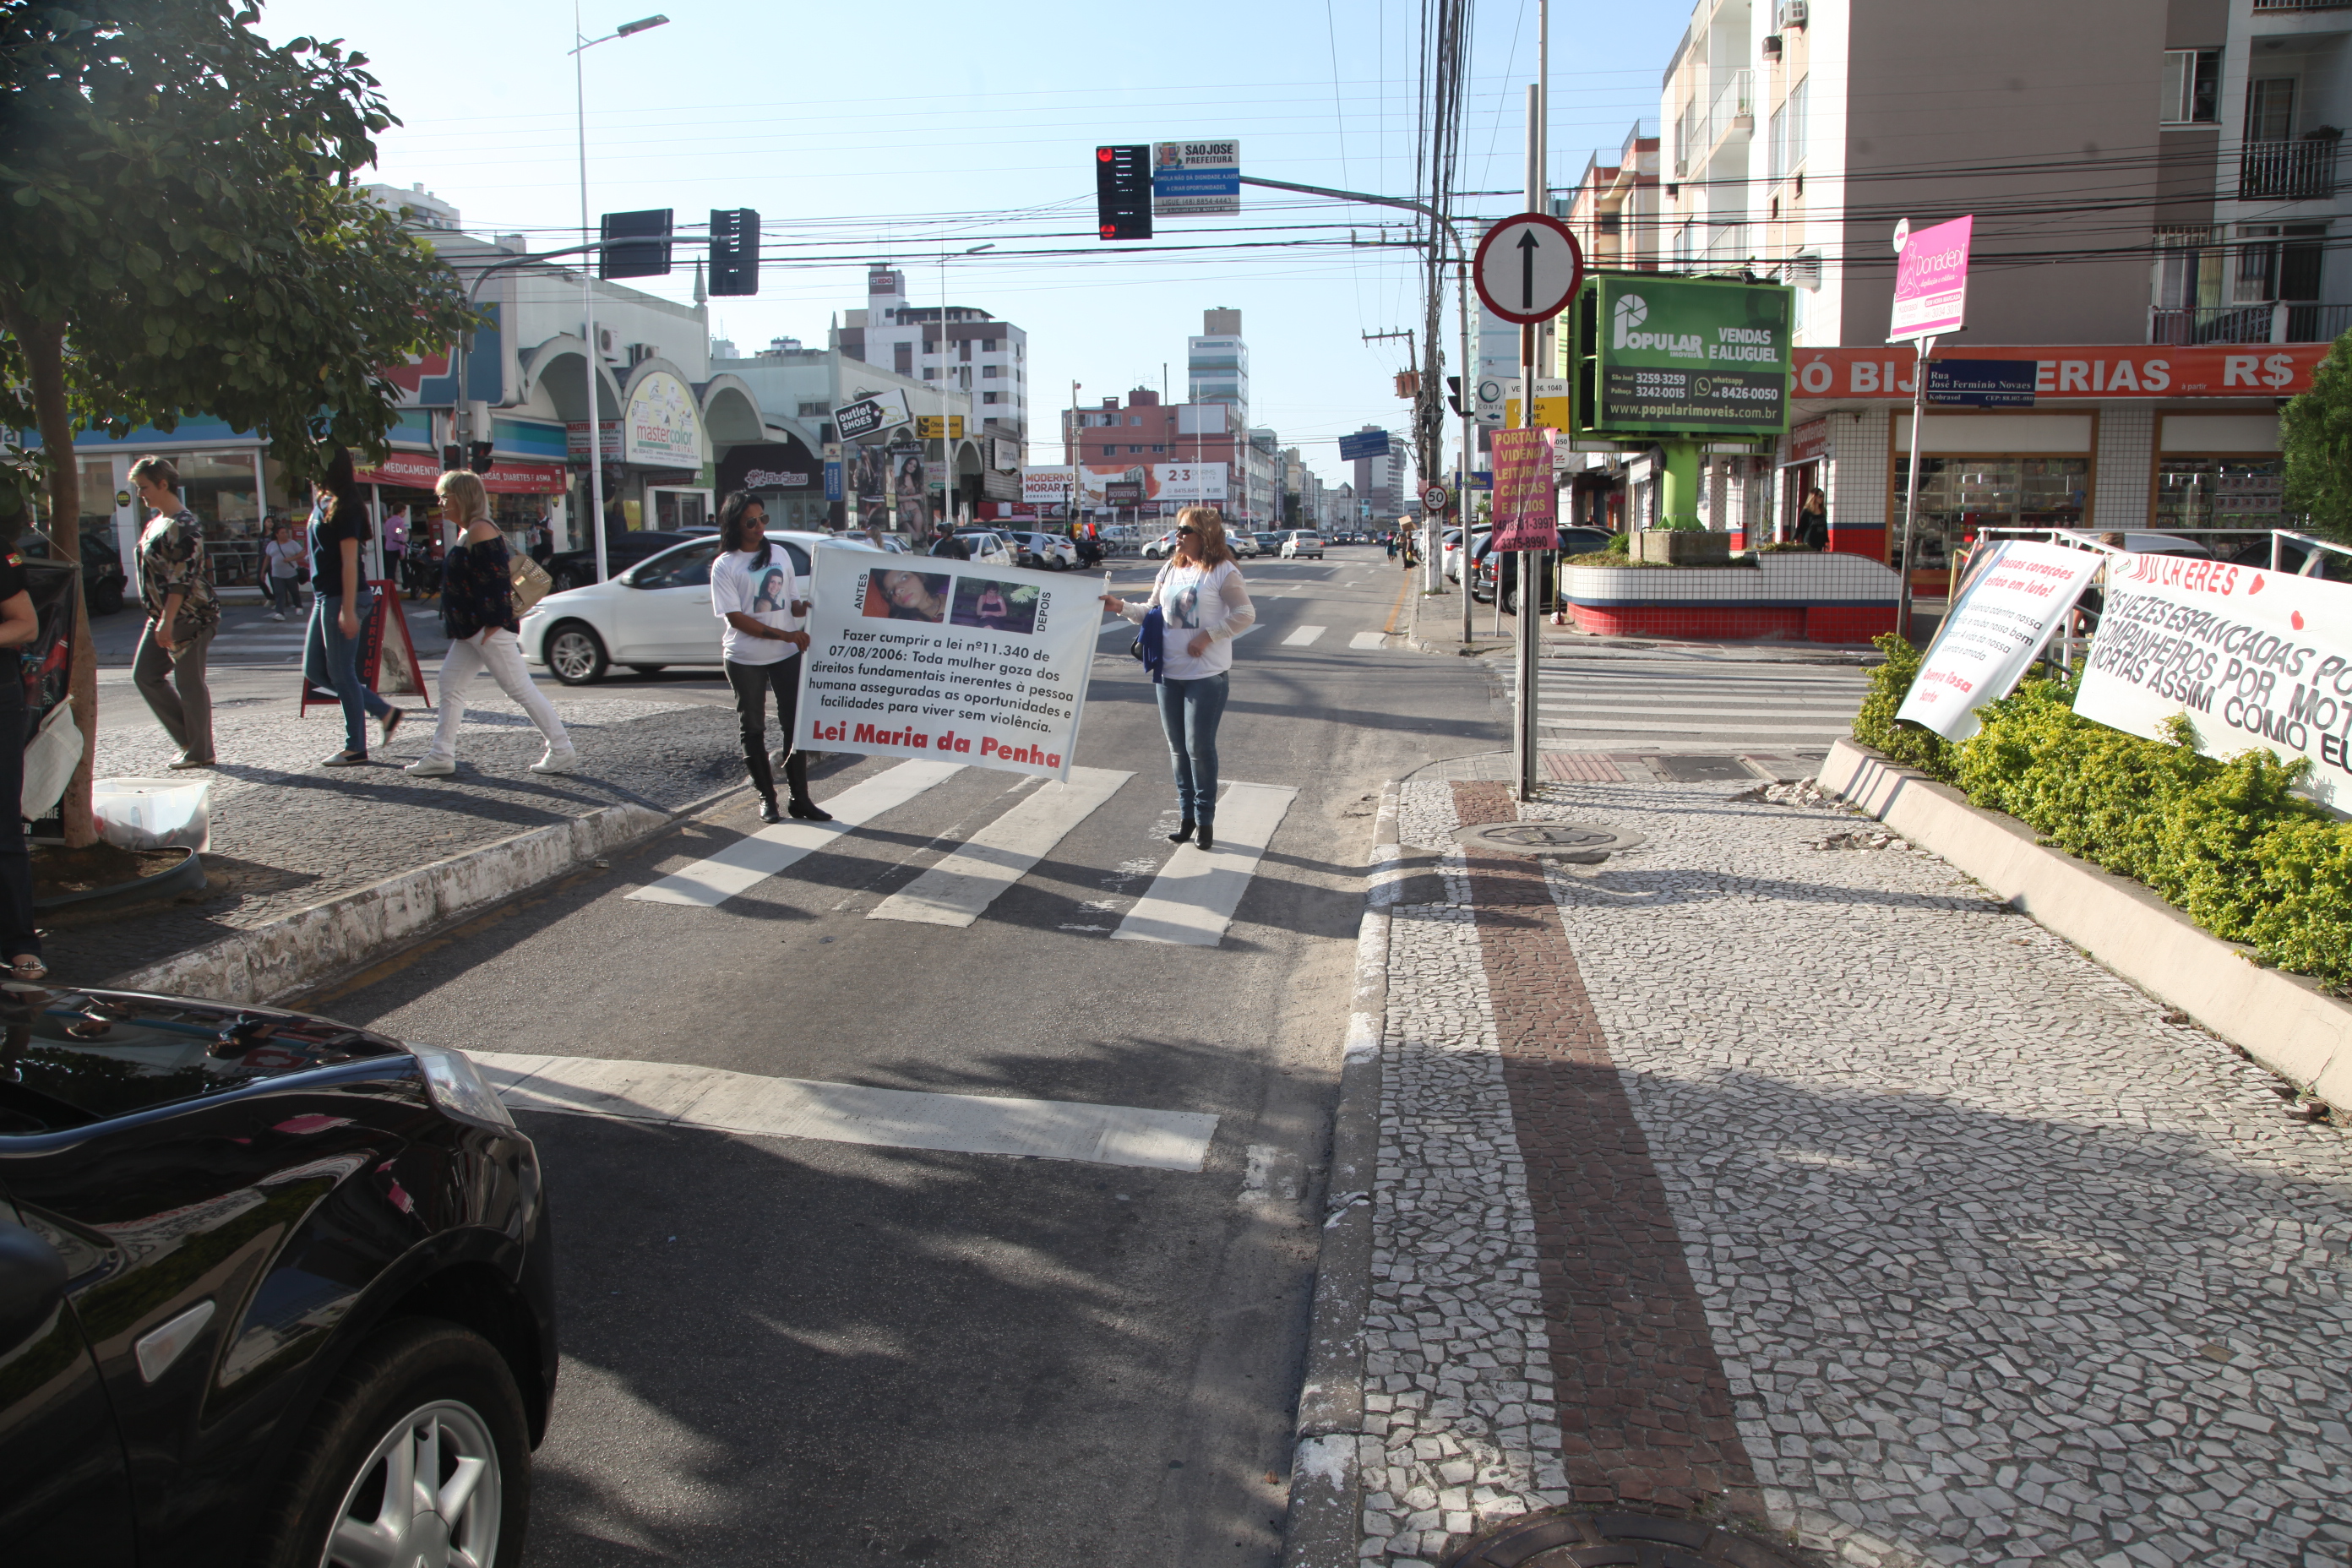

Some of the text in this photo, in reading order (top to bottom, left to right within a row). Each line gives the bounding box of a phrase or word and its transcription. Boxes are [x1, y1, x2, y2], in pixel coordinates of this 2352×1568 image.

[1185, 143, 1233, 155] SÃO JOSÉ
[1186, 155, 1233, 164] PREFEITURA
[1916, 243, 1965, 275] Donadepil
[1898, 301, 1918, 313] Kobrasol
[1932, 308, 1945, 318] 3034
[1946, 303, 1960, 315] 3010
[1614, 294, 1704, 358] POPULAR
[1718, 328, 1771, 345] VENDAS
[1709, 345, 1778, 362] E ALUGUEL
[1636, 373, 1685, 384] 3259-3259
[2224, 353, 2294, 389] R$
[1712, 377, 1743, 385] whatsapp
[1636, 387, 1685, 398] 3242-0015
[1722, 387, 1778, 400] 8426-0050
[839, 404, 871, 422] outlet
[1610, 404, 1777, 419] www.popularimoveis.com.br
[842, 415, 872, 431] SHOES
[637, 424, 693, 446] mastercolor
[1495, 431, 1538, 445] PORTAL
[1793, 422, 1826, 449] Bijouterias
[670, 445, 694, 454] DIGITAL
[1500, 446, 1546, 462] VIDÊNCIA
[1810, 444, 1820, 457] partir
[504, 473, 531, 482] DIABETES
[766, 472, 807, 484] FlorSexy
[1026, 473, 1073, 482] MODERNO
[1168, 470, 1177, 481] 2
[1182, 470, 1190, 481] 3
[1495, 463, 1550, 481] LEITURA DE
[1026, 483, 1060, 493] MORAR
[1500, 482, 1546, 497] CARTAS
[1428, 492, 1443, 503] 50
[1501, 498, 1545, 514] E BÚZIOS
[1501, 536, 1547, 549] 3375-8990
[2026, 561, 2075, 581] corações
[2128, 555, 2239, 596] MULHERES
[854, 574, 868, 610] ANTES
[1984, 575, 2056, 598] estão em luto!
[1037, 591, 1052, 632] DEPOIS
[1990, 606, 2015, 618] adentra
[2015, 613, 2043, 630] nossa
[363, 596, 380, 677] PIERCING
[1971, 616, 1990, 628] rouba
[1989, 623, 2008, 634] nosso
[2009, 626, 2034, 646] bem
[2118, 595, 2175, 626] VEZES
[2164, 606, 2316, 678] ESPANCADAS
[843, 629, 875, 641] Fazer
[879, 632, 930, 648] cumprir
[934, 639, 942, 648] a
[946, 638, 962, 651] lei
[1033, 650, 1050, 662] de
[1965, 631, 1977, 640] vida
[1976, 633, 1986, 643] da
[1985, 639, 2011, 654] nossa
[1963, 648, 1986, 661] amada
[829, 645, 1060, 682] 07/08/2006: Toda mulher goza dos
[812, 661, 1074, 702] direitos fundamentais inerentes à pessoa
[1944, 671, 1973, 693] Rosa
[2218, 657, 2276, 707] POR
[808, 678, 1071, 720] humana asseguradas as oportunidades e
[2088, 644, 2148, 684] MORTAS
[2147, 666, 2216, 714] ASSIM
[2224, 696, 2307, 751] COMO
[820, 694, 1052, 733] facilidades para viver sem violência.
[813, 721, 1061, 769] Lei Maria da Penha
